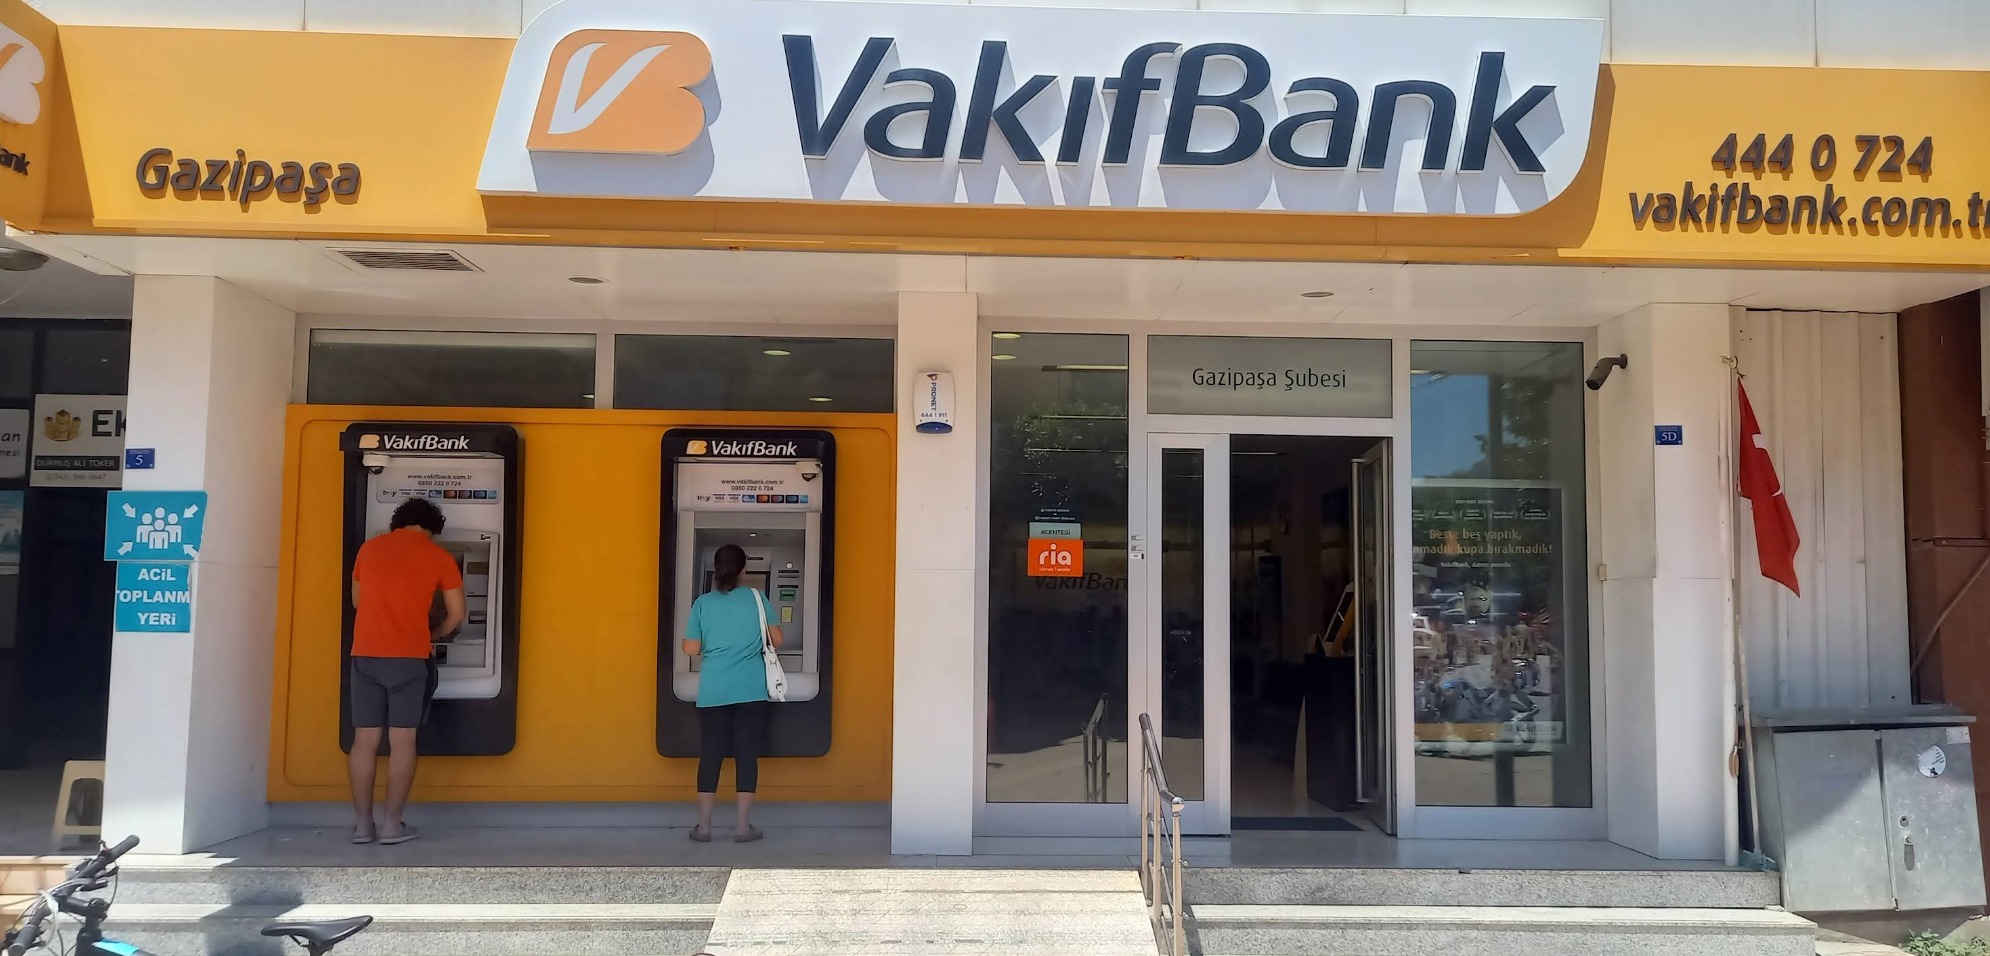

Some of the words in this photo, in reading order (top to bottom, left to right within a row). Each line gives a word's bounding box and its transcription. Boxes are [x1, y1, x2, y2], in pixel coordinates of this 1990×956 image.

[782, 34, 1558, 173] VakıfBank
[1711, 132, 1795, 172] 444
[1810, 134, 1836, 172] 0
[1854, 134, 1934, 174] 724
[136, 147, 361, 205] Gazipaşa
[1192, 367, 1277, 391] Gazipaşa
[1284, 368, 1346, 391] Şubesi
[0, 432, 21, 442] an
[383, 435, 470, 450] VakıfBank
[1661, 431, 1677, 441] 5D
[711, 441, 797, 456] VakıfBank
[89, 459, 115, 468] TOKER
[134, 454, 144, 466] 5
[1462, 528, 1481, 541] beş
[1039, 543, 1072, 566] ria
